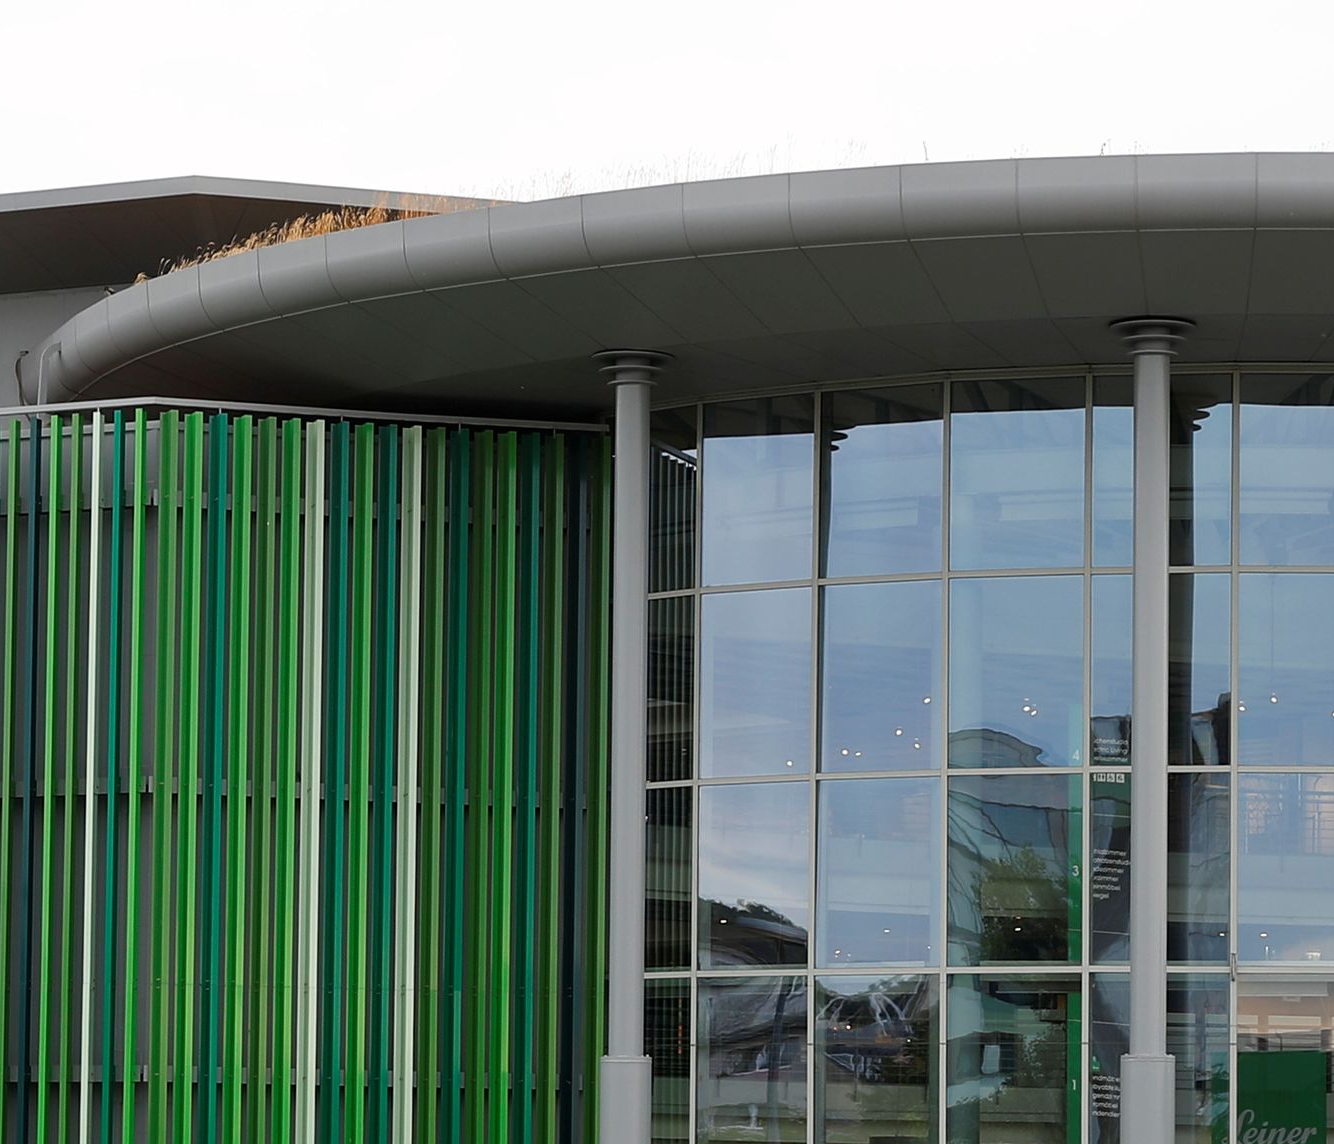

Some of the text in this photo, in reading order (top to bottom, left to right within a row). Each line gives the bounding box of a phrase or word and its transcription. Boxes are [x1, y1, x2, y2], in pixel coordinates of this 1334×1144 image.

[1071, 750, 1080, 761] 4
[1071, 865, 1080, 877] 3
[1071, 1079, 1077, 1091] 1
